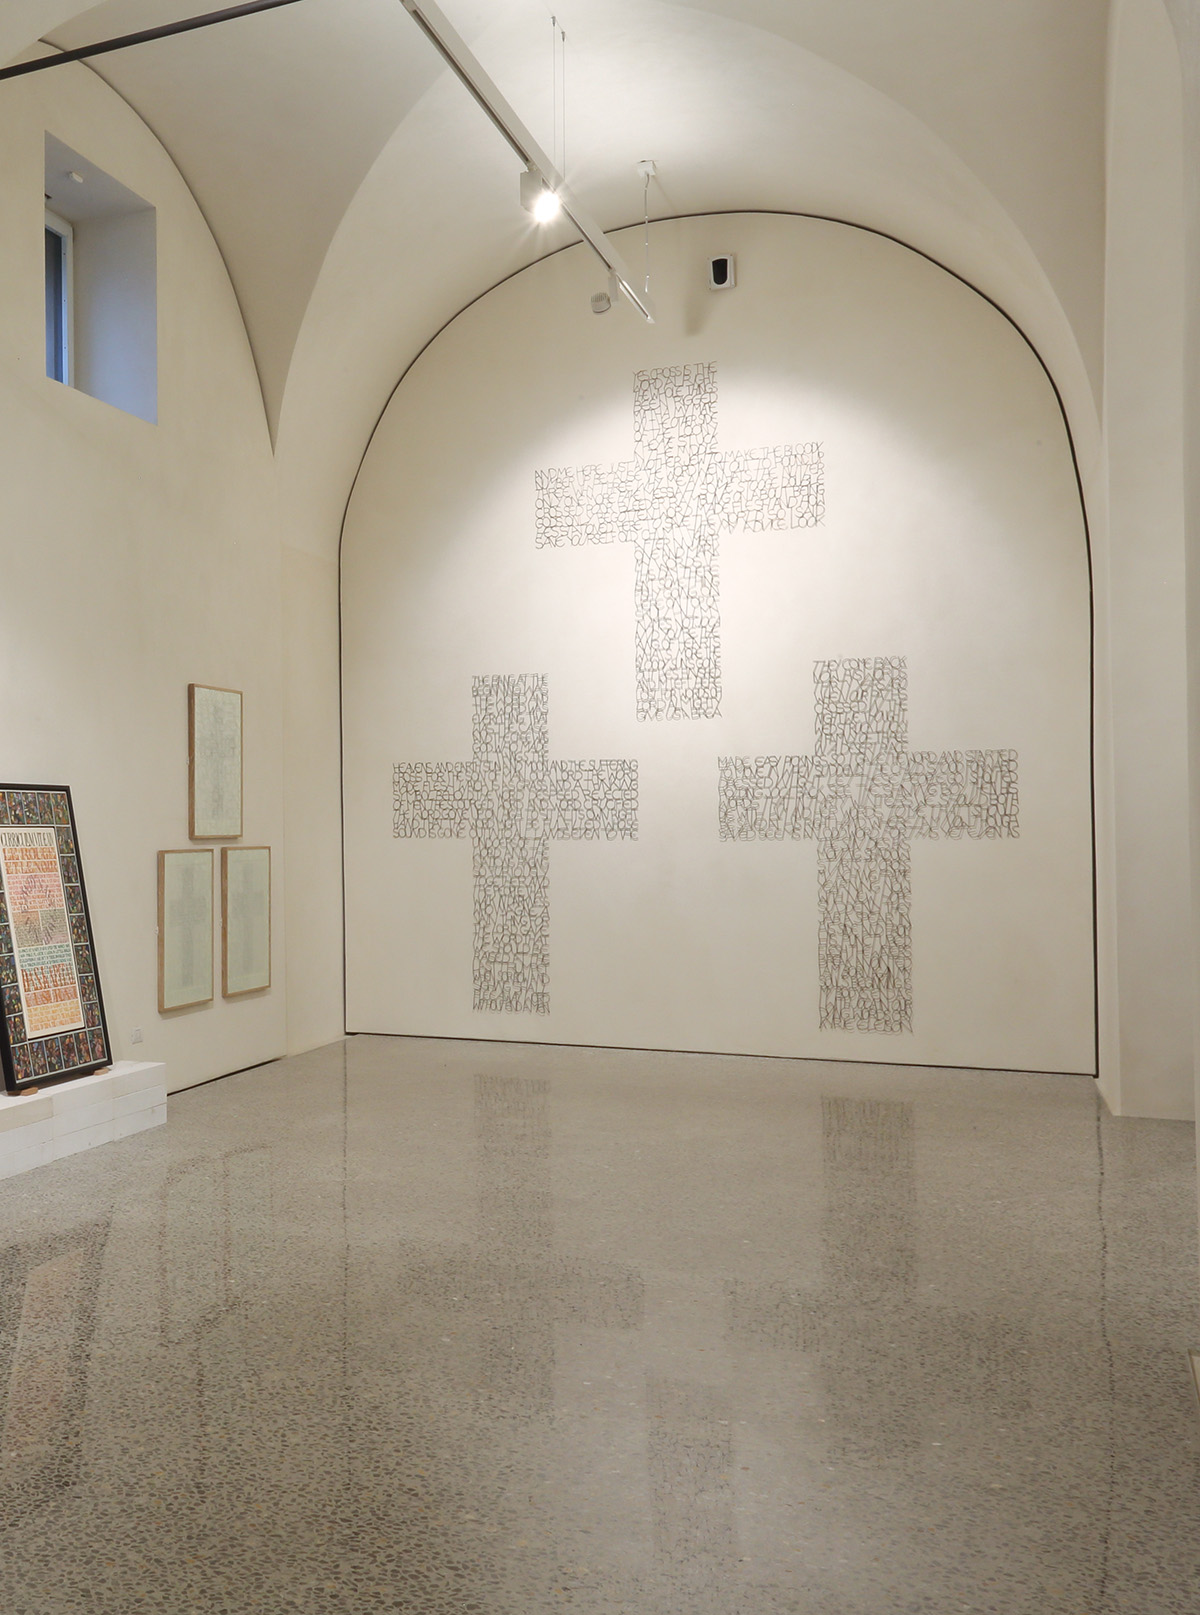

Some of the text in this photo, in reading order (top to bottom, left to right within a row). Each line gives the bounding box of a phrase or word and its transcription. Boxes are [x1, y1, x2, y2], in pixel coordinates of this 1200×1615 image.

[632, 361, 717, 391] YES CROSS IS THE
[535, 468, 557, 480] AND
[558, 466, 573, 477] ME
[576, 463, 602, 478] HERE
[724, 448, 759, 460] MAKE
[760, 445, 782, 460] THE
[784, 442, 823, 456] BLOODY
[535, 537, 564, 549] SAVE
[743, 519, 788, 533] ADVICE
[790, 515, 825, 529] LOOK
[842, 658, 873, 670] COME
[875, 656, 908, 669] BACK
[435, 762, 453, 774] AND
[455, 762, 480, 773] EARTH
[568, 760, 588, 771] THE
[589, 759, 638, 772] SUFFERING
[718, 756, 750, 768] MADE
[755, 756, 781, 767] EASY
[393, 829, 466, 839] SOUND IS GONE
